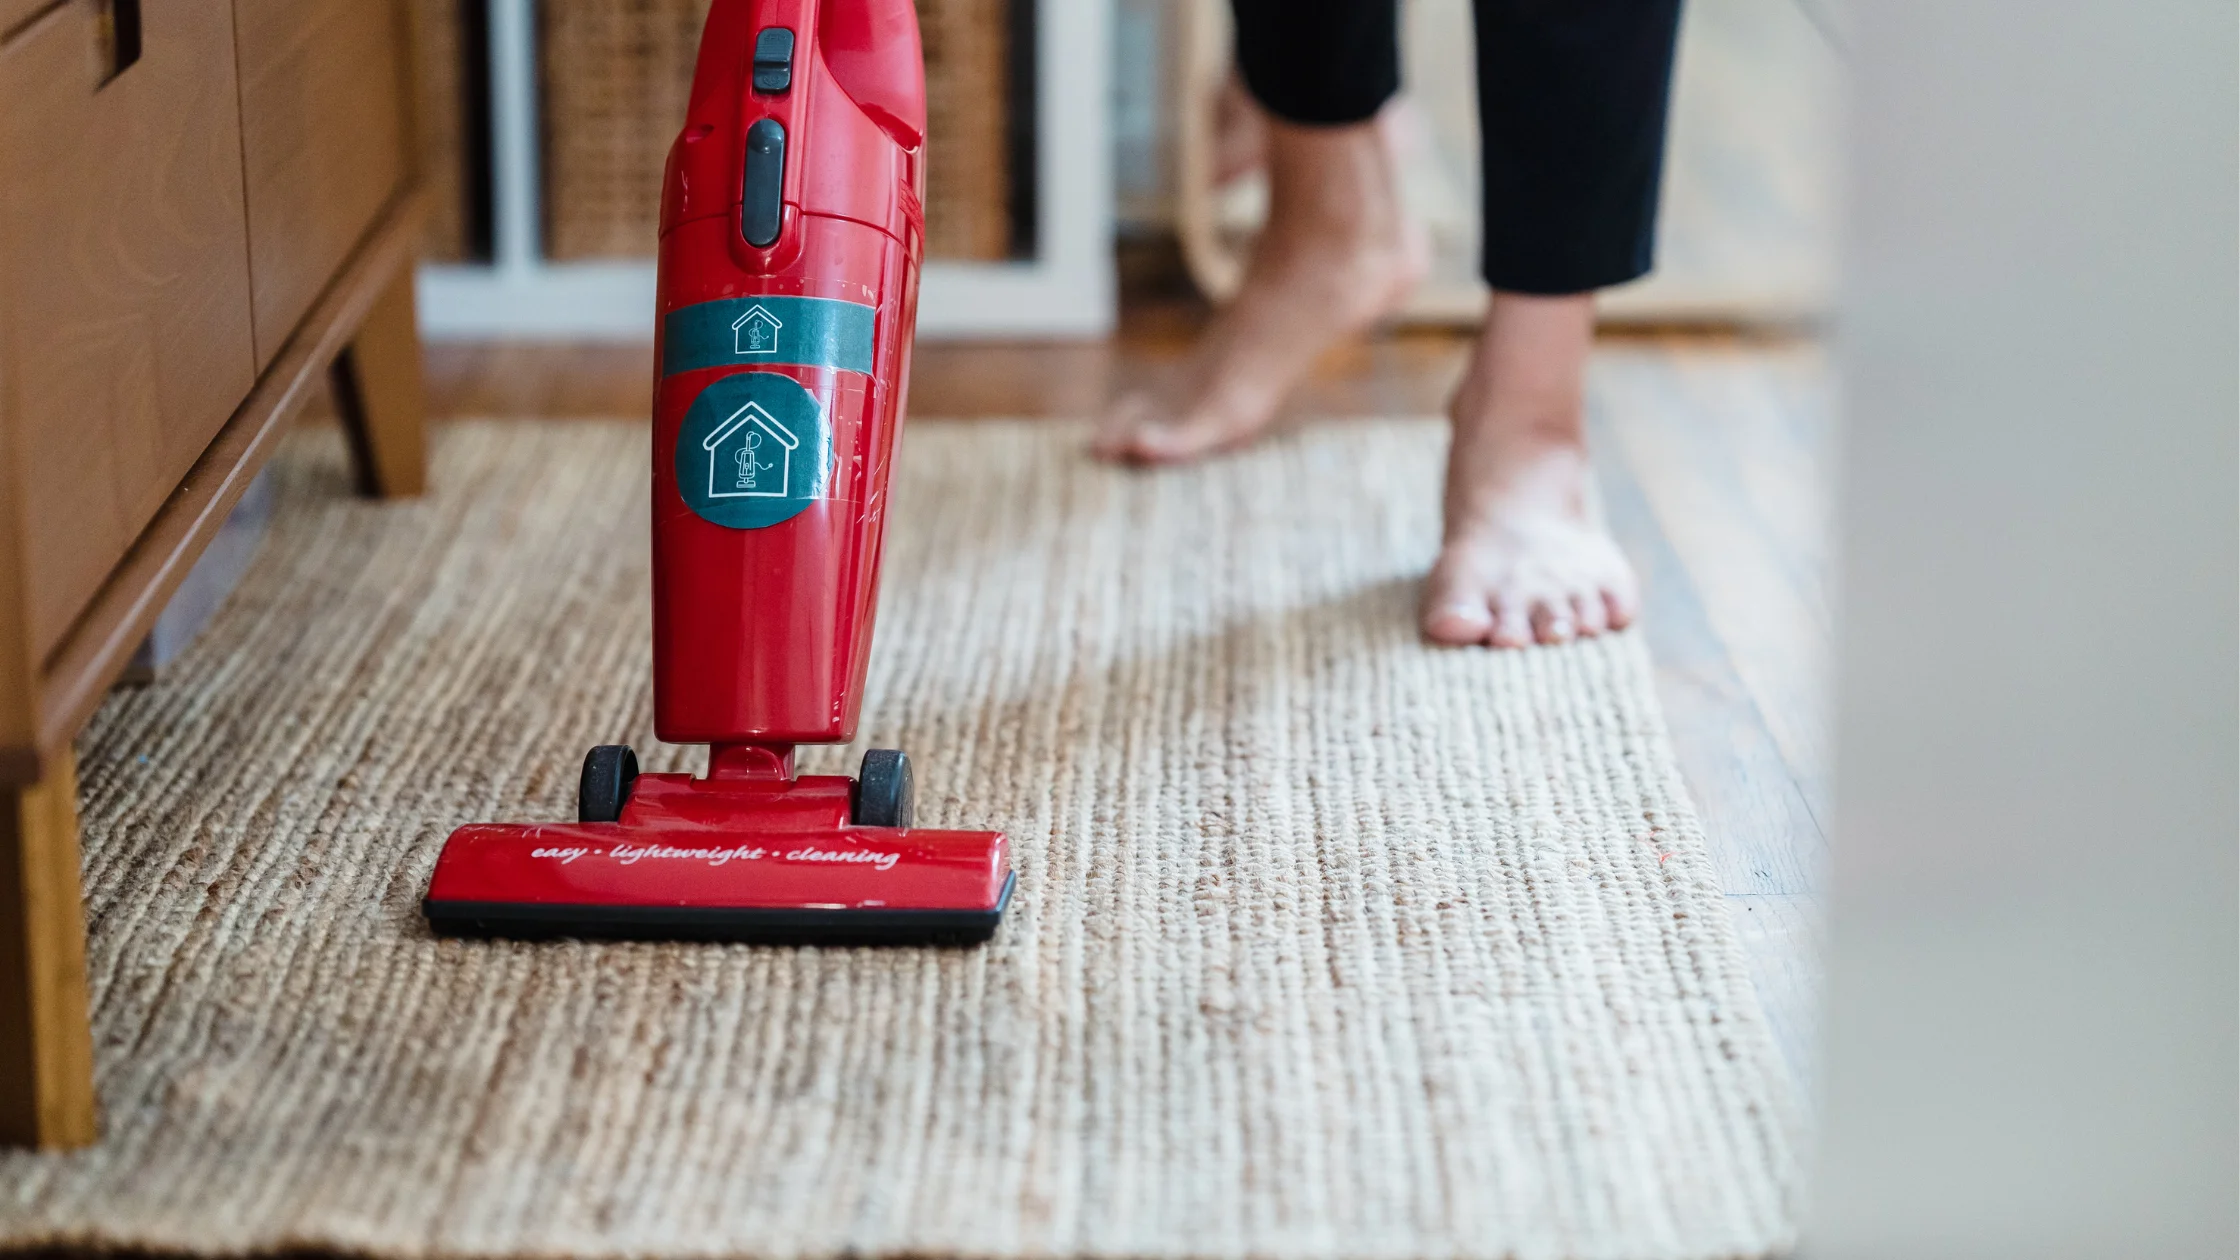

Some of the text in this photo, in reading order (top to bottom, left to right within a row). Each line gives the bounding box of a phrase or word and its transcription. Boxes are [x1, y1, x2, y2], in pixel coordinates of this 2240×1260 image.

[531, 843, 901, 871] easy lightweight cleaning
